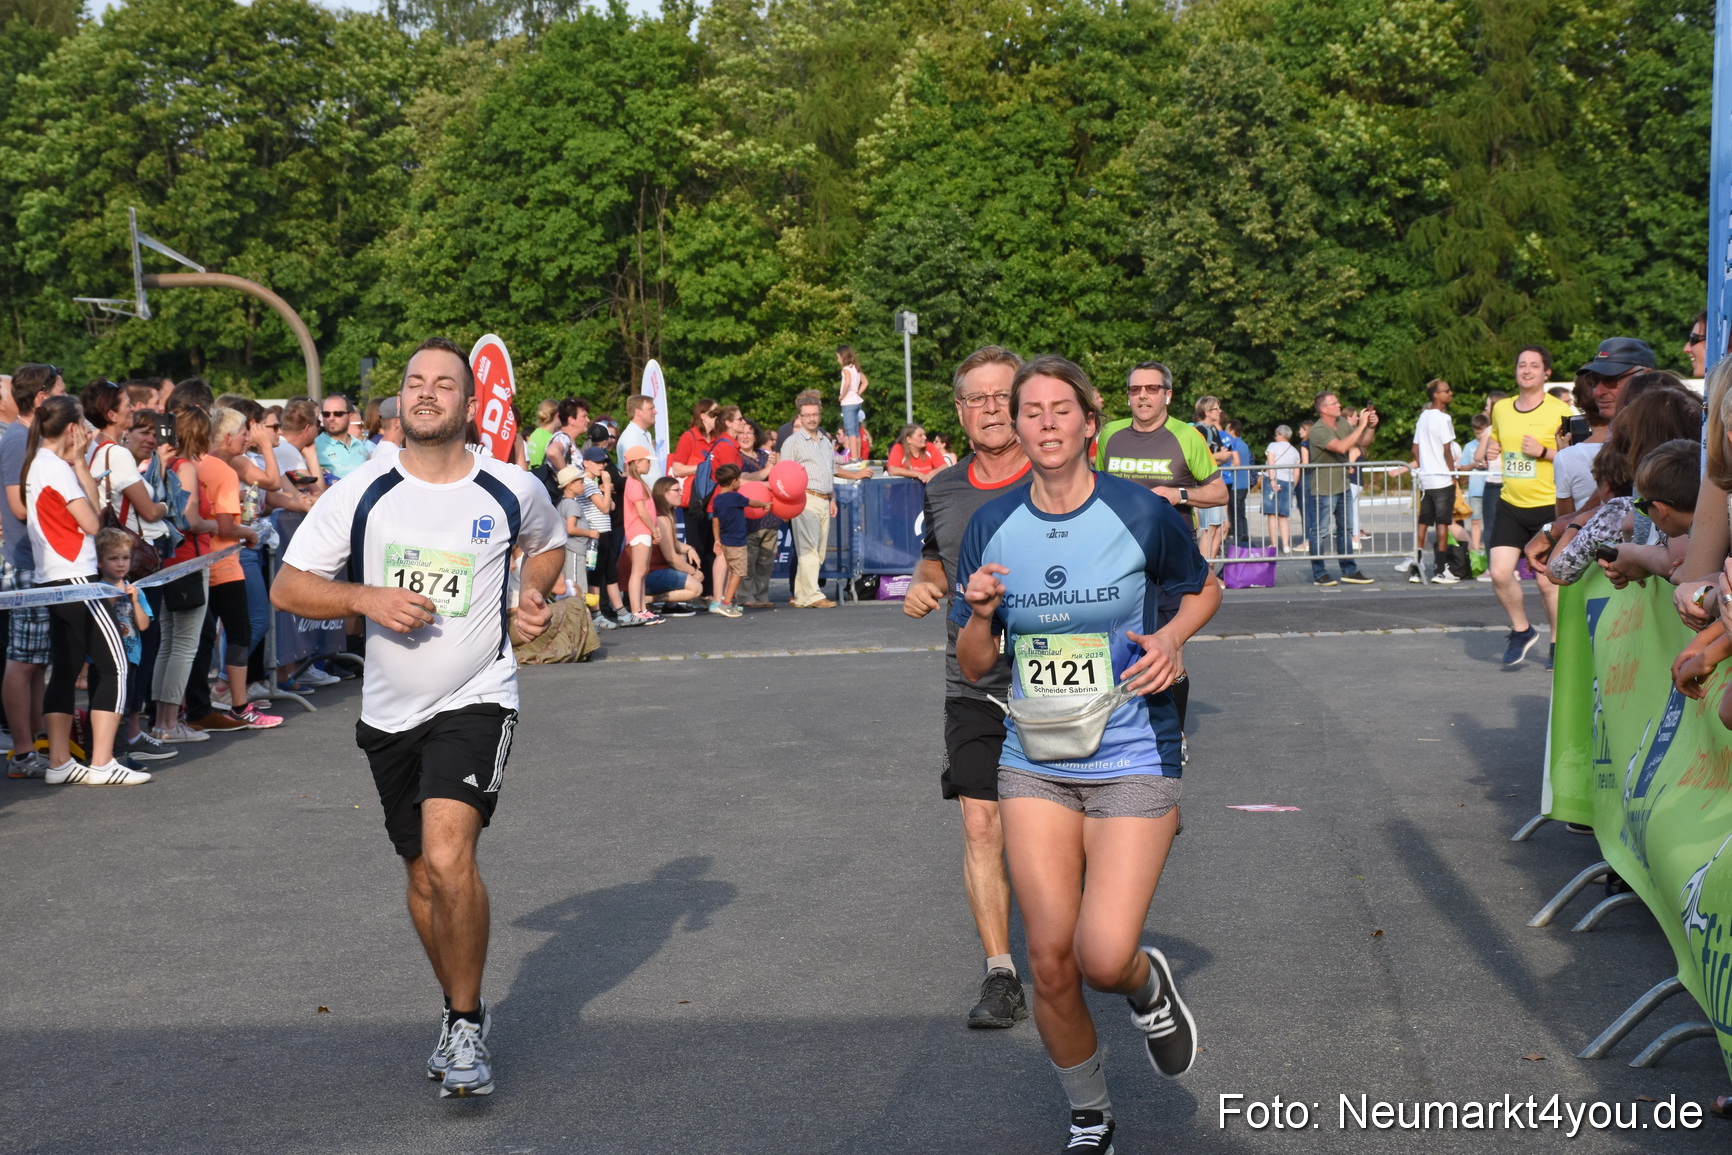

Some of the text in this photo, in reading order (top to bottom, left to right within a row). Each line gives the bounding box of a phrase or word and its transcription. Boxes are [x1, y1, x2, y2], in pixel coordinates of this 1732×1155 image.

[477, 355, 488, 382] AVIA
[1108, 458, 1169, 473] BOCK
[1507, 461, 1532, 471] 2186
[451, 568, 468, 576] 2019
[394, 569, 460, 598] 1874
[1038, 613, 1070, 624] TEAM
[1085, 651, 1104, 659] 2019
[1028, 659, 1095, 686] 2121
[1034, 685, 1098, 694] Schneider Sabrina
